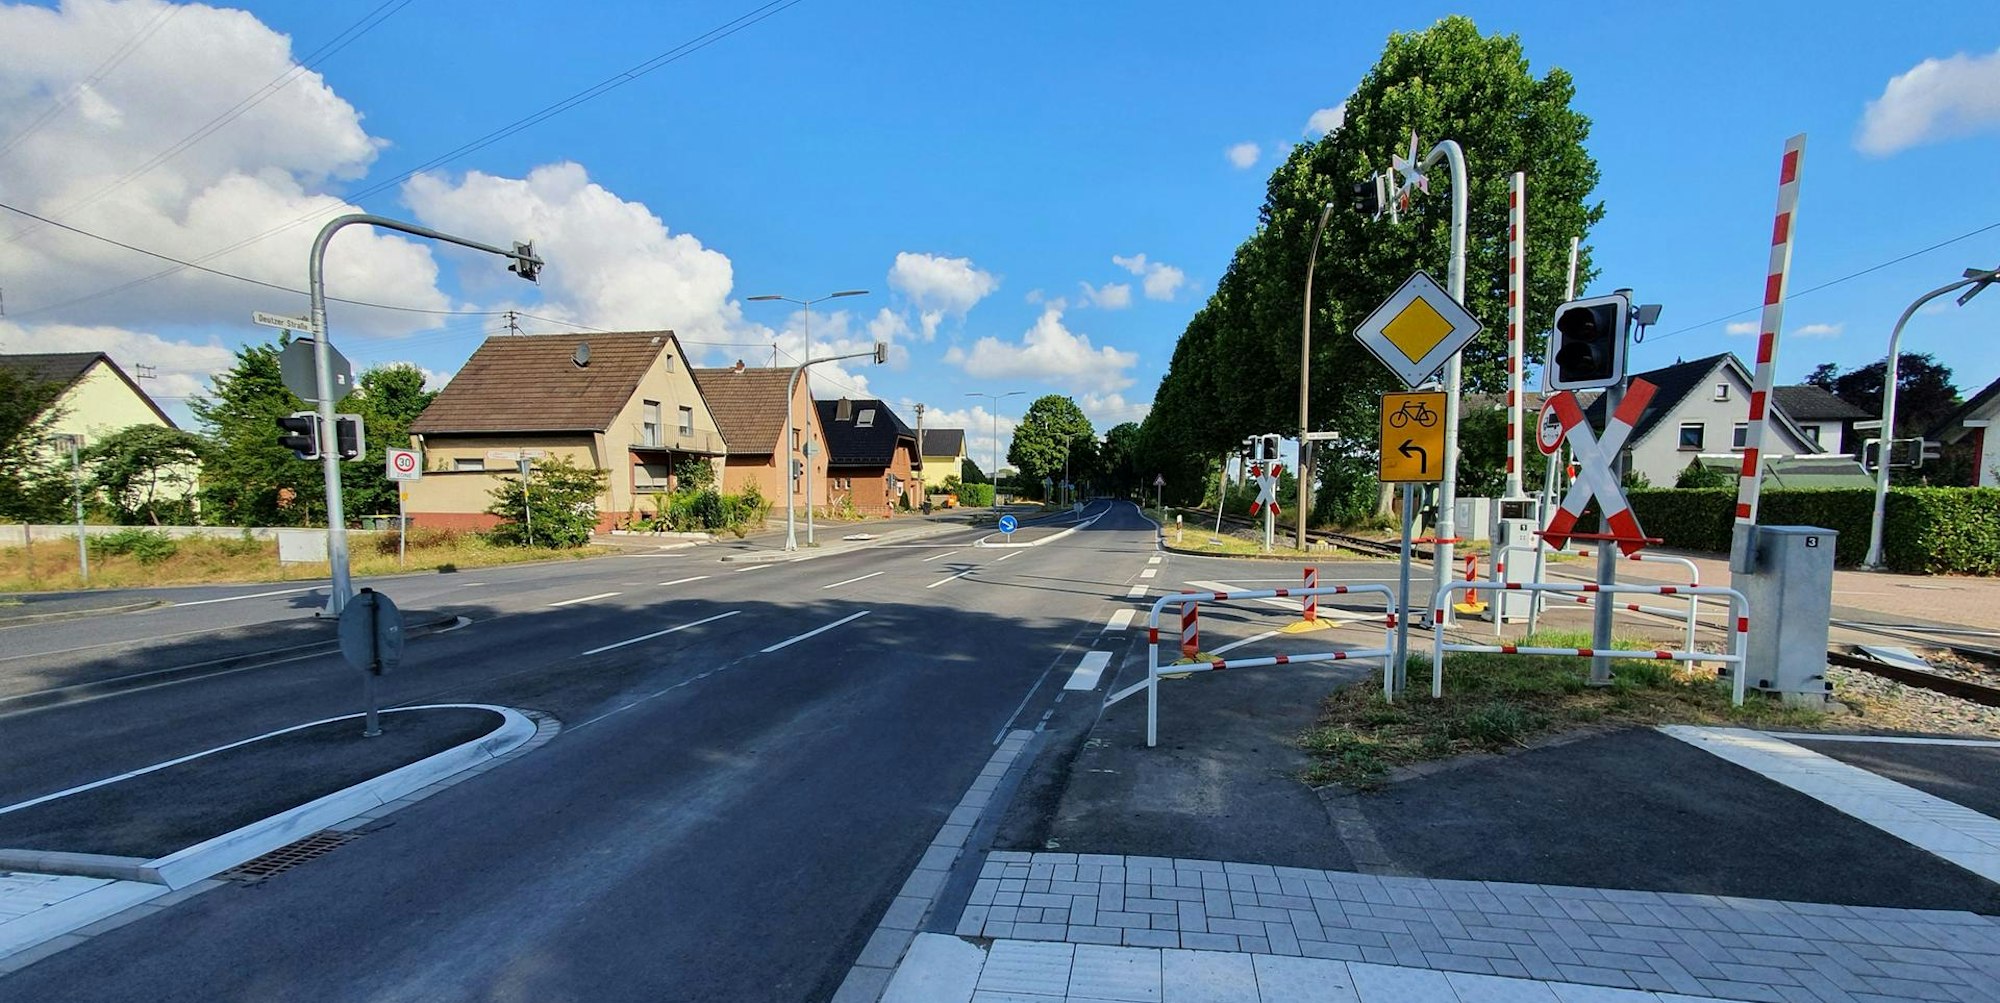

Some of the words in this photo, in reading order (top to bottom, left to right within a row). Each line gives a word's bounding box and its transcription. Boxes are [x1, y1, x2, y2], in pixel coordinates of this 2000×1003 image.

[258, 314, 284, 326] Deutzer
[287, 319, 308, 330] Straße
[399, 458, 410, 467] 30
[1808, 537, 1816, 547] 3
